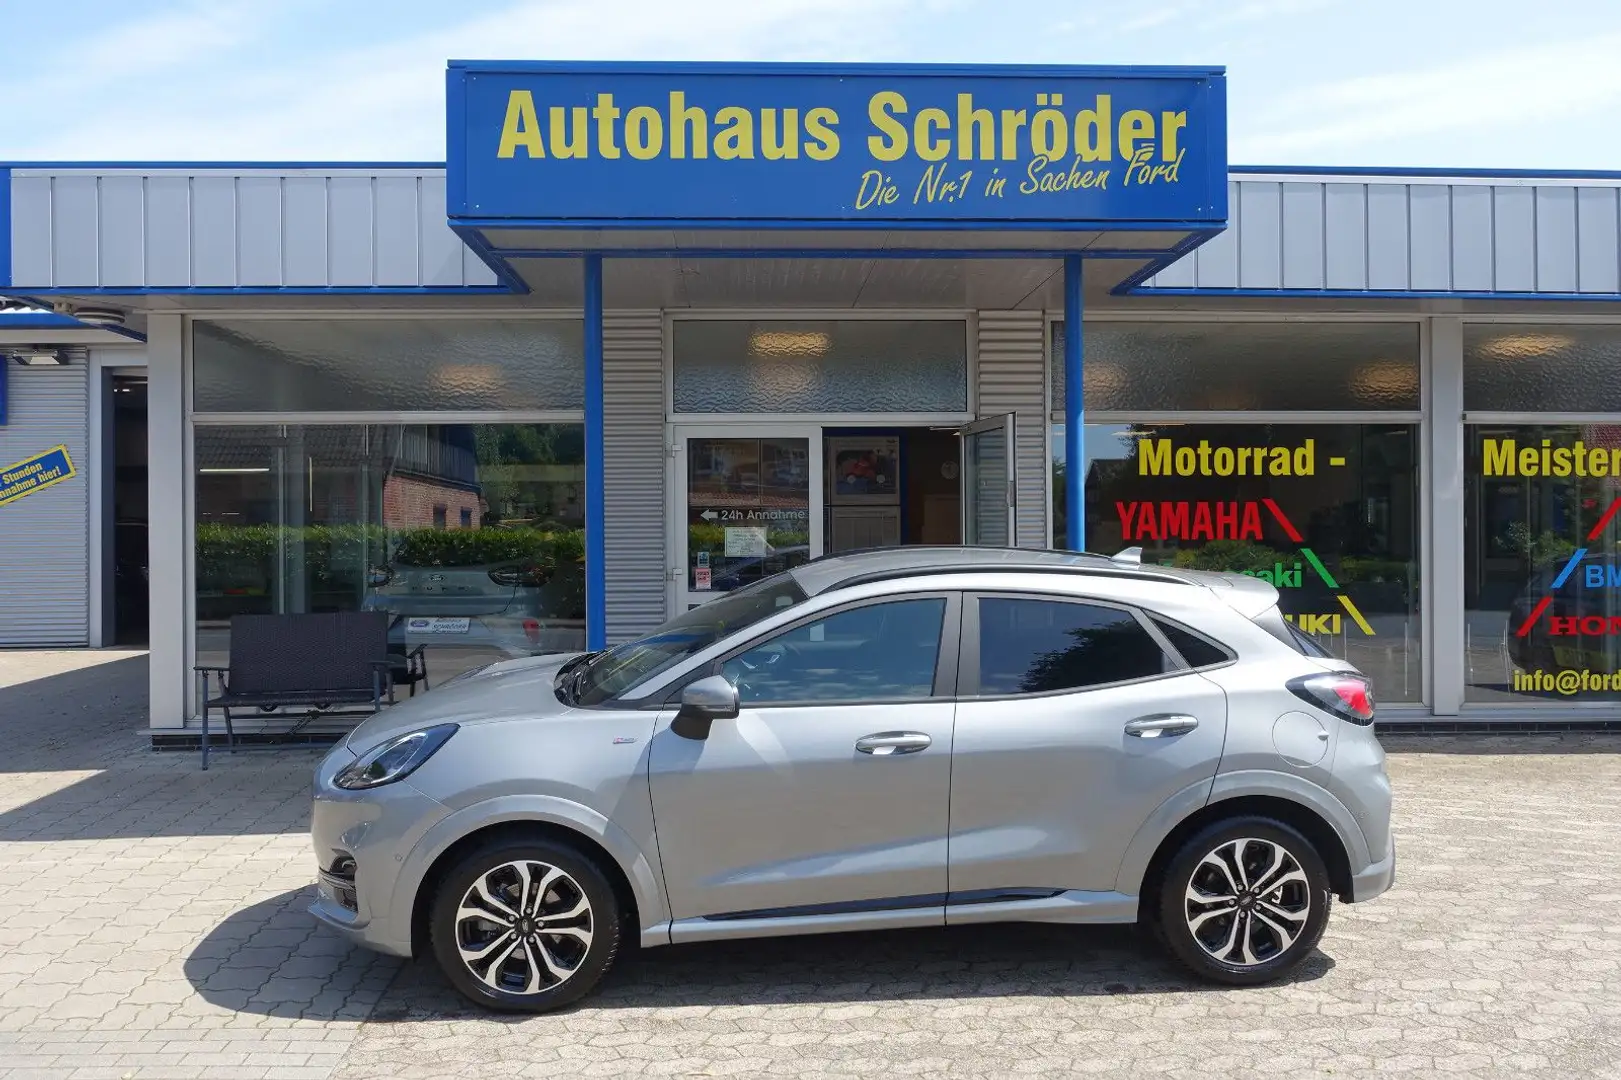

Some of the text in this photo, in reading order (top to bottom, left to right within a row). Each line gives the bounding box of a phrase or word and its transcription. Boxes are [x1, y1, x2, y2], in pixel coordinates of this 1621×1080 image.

[497, 90, 1187, 163] Autohaus Schröder
[855, 170, 900, 210] Die
[984, 168, 1006, 198] in
[1019, 154, 1110, 194] Sachen
[1123, 143, 1186, 187] Ford
[2, 463, 43, 485] Stunden
[37, 465, 61, 483] hier!
[1138, 438, 1315, 476] Motorrad
[1483, 439, 1621, 477] Meister
[721, 510, 805, 520] 24h Annahme
[1115, 501, 1263, 540] YAMAHA
